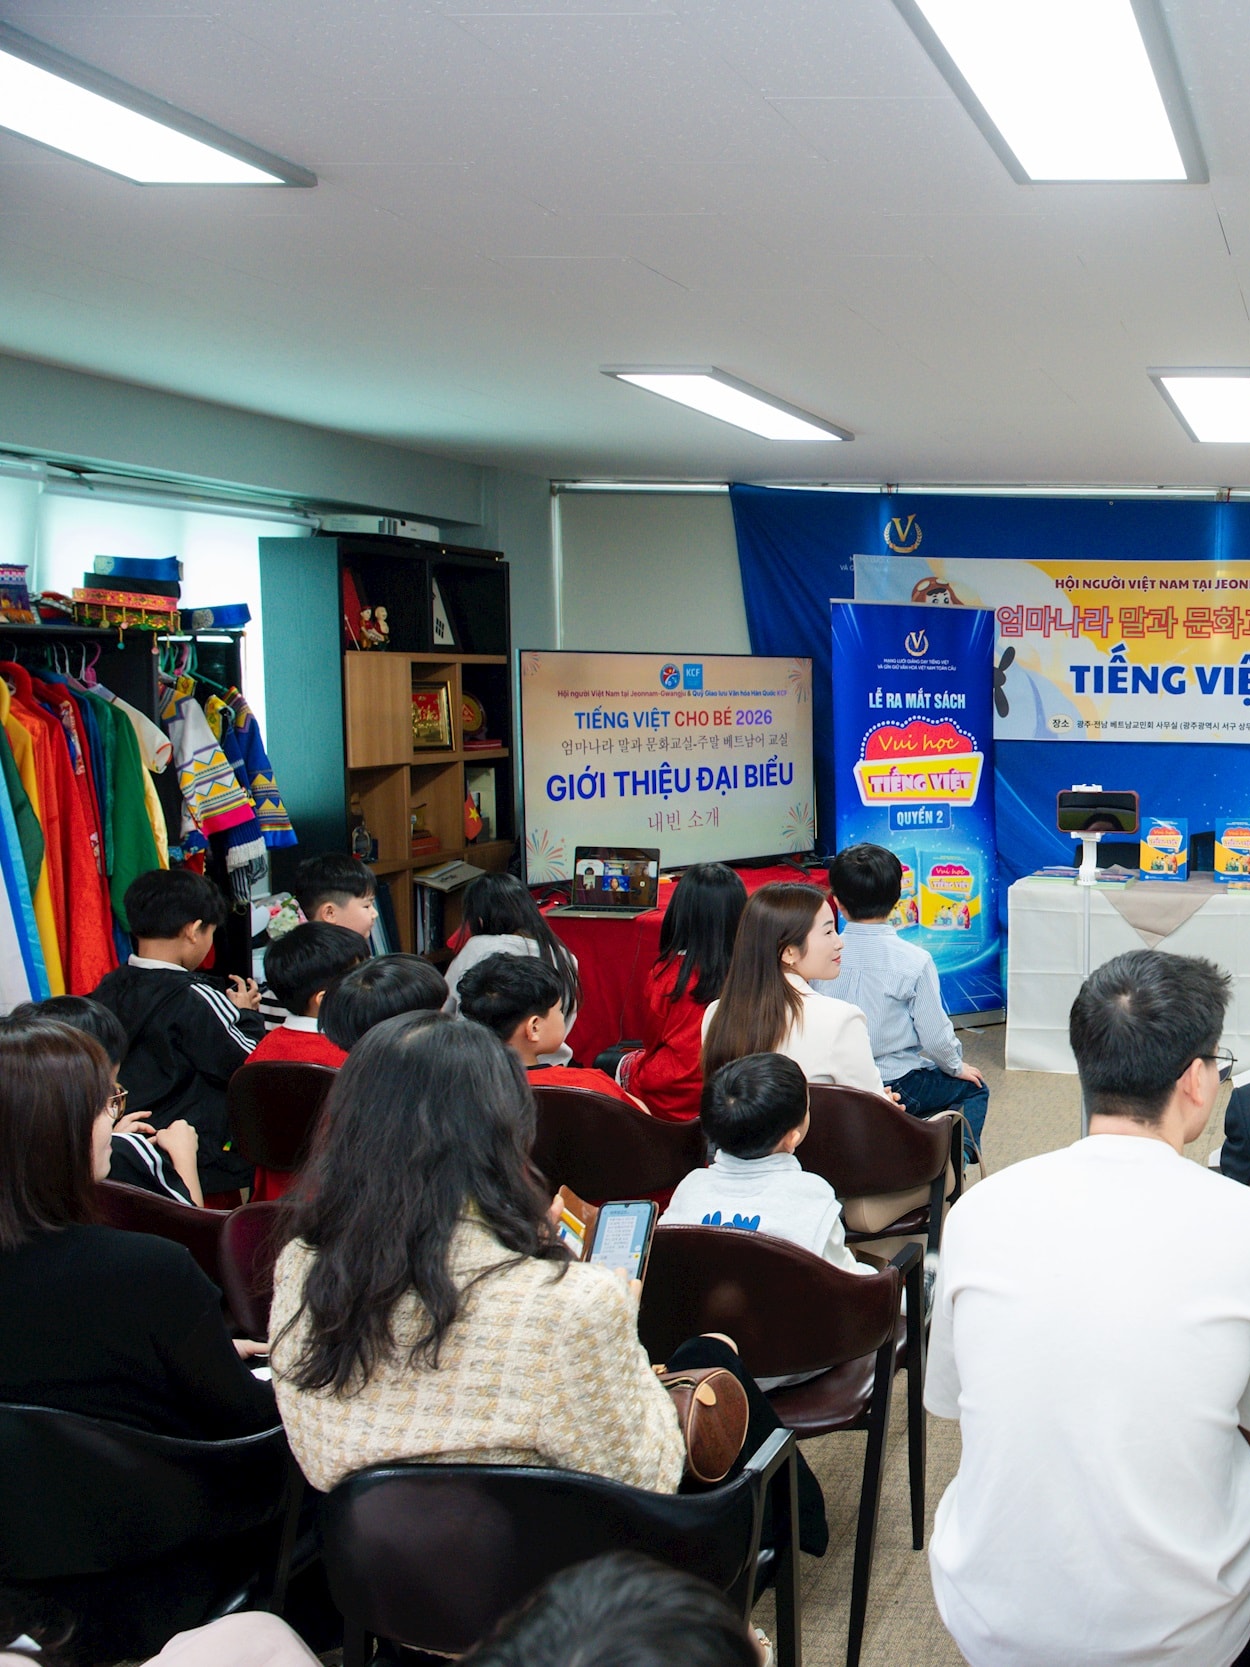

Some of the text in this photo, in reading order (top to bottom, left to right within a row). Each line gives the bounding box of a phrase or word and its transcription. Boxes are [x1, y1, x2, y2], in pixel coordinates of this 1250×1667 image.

[1055, 575, 1079, 592] HỘI
[1083, 575, 1125, 590] NGƯỜI
[1128, 575, 1156, 592] VIỆT
[1159, 579, 1189, 590] NAM
[1192, 579, 1212, 592] TẠI
[996, 605, 1113, 639] 엄마나라
[1119, 605, 1178, 640] 말과
[686, 668, 700, 677] KCF
[1069, 643, 1187, 695] TIẾNG
[558, 690, 569, 698] Hội
[570, 690, 589, 698] người
[591, 690, 604, 698] Việt
[621, 690, 629, 698] tại
[630, 690, 686, 699] Jeonnam-Gwangju
[869, 687, 966, 709] LỄ RA MẮT SÁCH
[574, 705, 773, 732] TIẾNG VIỆT CHO BÉ 2026
[1052, 719, 1070, 729] 장소
[1110, 721, 1154, 730] 베트남교민회
[1156, 721, 1178, 730] 사무실
[1179, 721, 1220, 731] (광주광역시
[1222, 722, 1237, 731] 서구
[561, 736, 614, 756] 엄마나라
[618, 736, 642, 754] 말과
[723, 732, 765, 750] 베트남어
[768, 732, 788, 748] 교실
[878, 734, 960, 752] Vui học
[546, 754, 793, 801] GIỚI THIỆU ĐẠI BIỂU
[868, 766, 972, 793] TIẾNG VIỆT
[648, 806, 720, 833] 내빈 소개
[896, 805, 944, 826] QUYỂN 2
